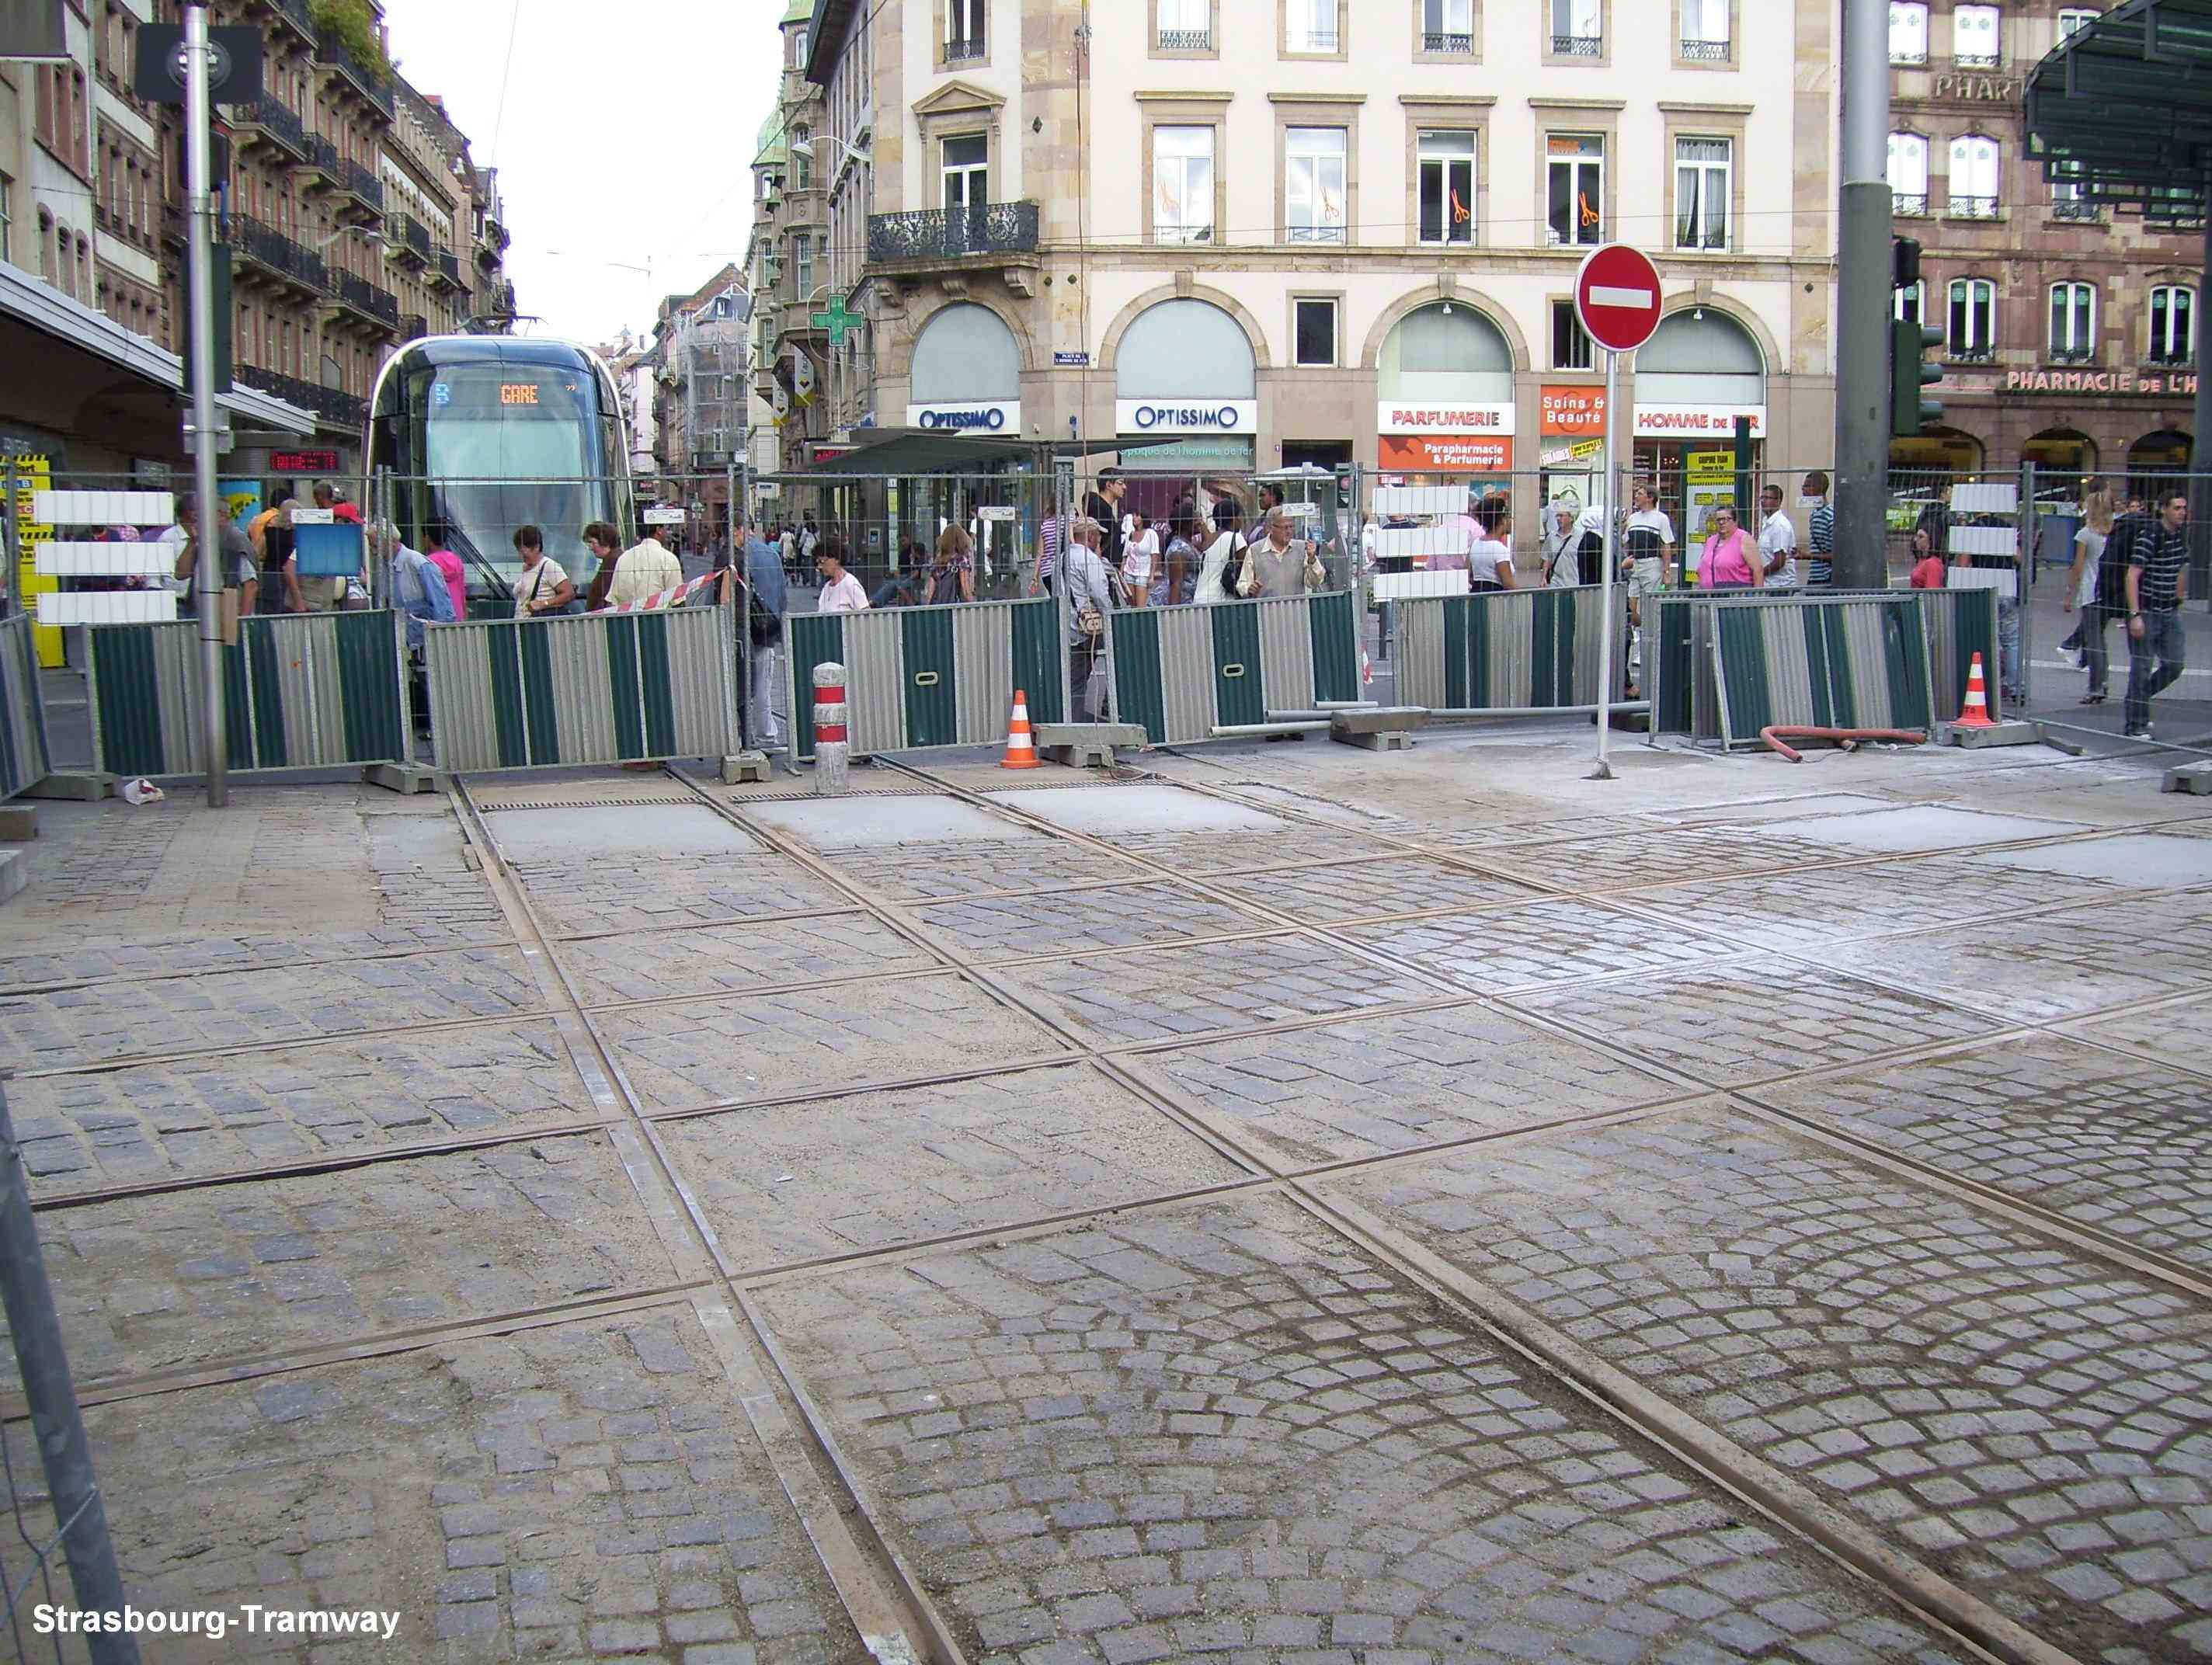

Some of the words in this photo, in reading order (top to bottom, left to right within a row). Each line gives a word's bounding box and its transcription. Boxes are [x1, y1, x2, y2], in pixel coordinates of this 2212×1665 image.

[2006, 370, 2132, 391] PHARMACIE
[2137, 378, 2163, 393] DE
[2168, 374, 2198, 393] L'H
[500, 384, 539, 404] GARE
[1542, 396, 1586, 409] Soins
[919, 408, 1005, 430] OPTISSIMO
[1135, 406, 1239, 428] OPTISSIMO
[1392, 410, 1500, 426] PARFUMERIE
[1546, 410, 1601, 423] Beauté
[1638, 413, 1709, 429] HOMME
[1713, 418, 1728, 429] DE
[1732, 414, 1760, 429] FR
[1163, 446, 1175, 455] de
[1424, 443, 1504, 454] Parapharmacie
[1433, 455, 1442, 464] &
[1443, 454, 1504, 465] Parfumerie
